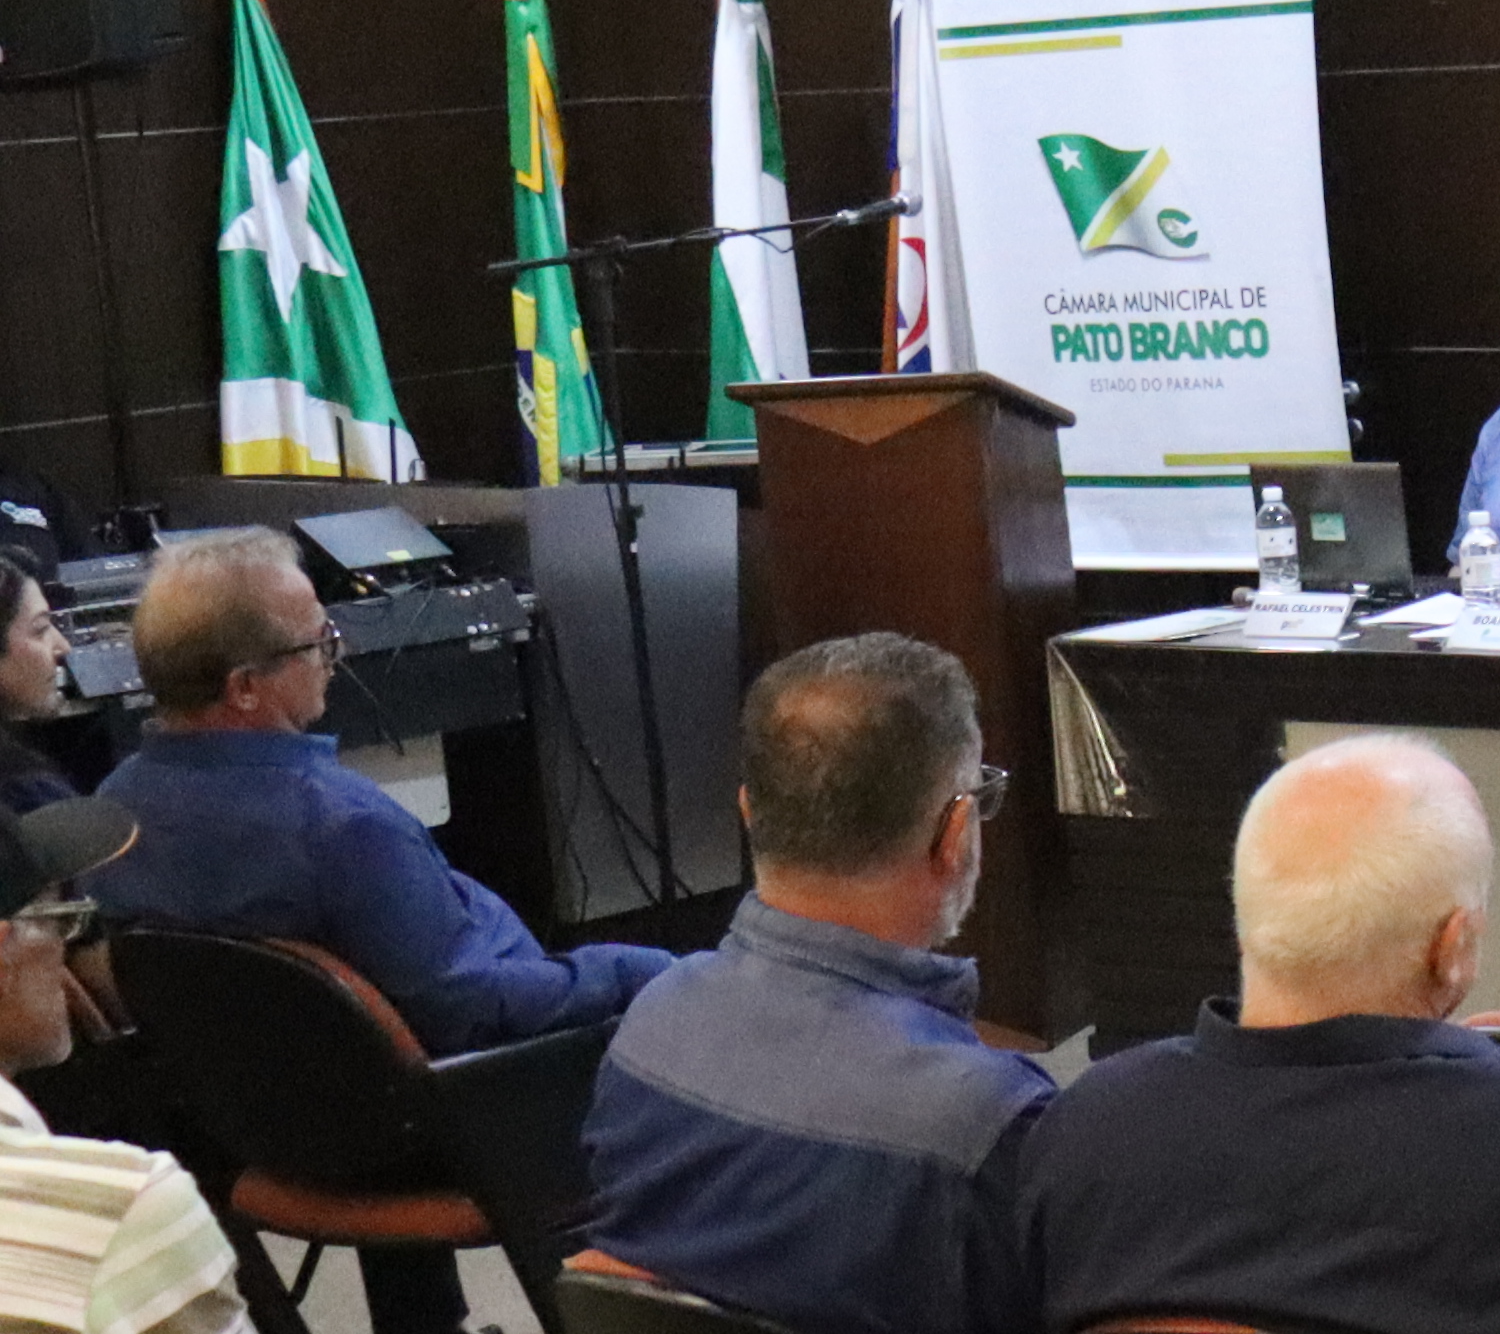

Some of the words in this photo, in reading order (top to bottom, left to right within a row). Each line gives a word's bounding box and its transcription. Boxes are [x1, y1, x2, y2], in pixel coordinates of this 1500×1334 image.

[1044, 288, 1118, 315] CÂMARA
[1124, 288, 1233, 312] MUNICIPAL
[1241, 286, 1267, 308] DE
[1051, 323, 1124, 362] PATO
[1128, 317, 1269, 361] BRANCO
[1091, 378, 1136, 392] ESTADO
[1142, 378, 1162, 391] DO
[1255, 603, 1290, 613] RAFAEL
